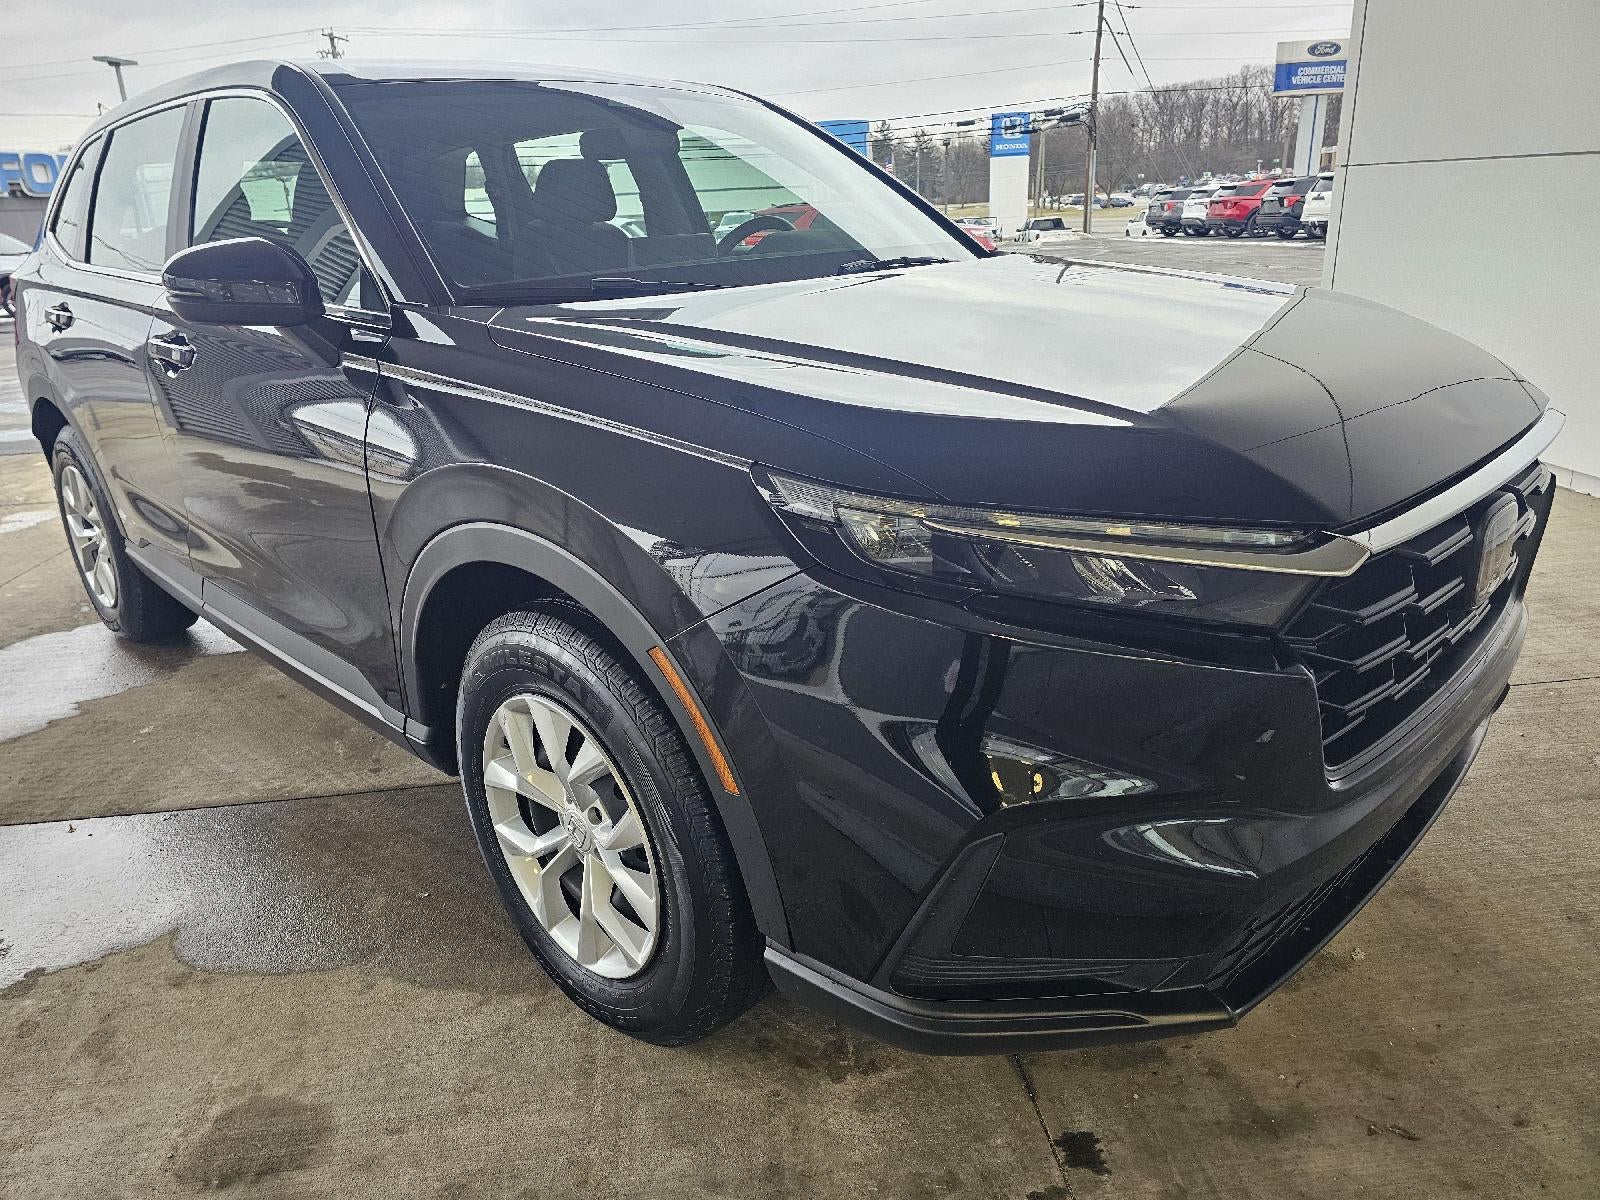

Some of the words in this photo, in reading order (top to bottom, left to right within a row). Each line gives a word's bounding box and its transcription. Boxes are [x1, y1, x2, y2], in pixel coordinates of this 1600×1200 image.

[1314, 43, 1337, 55] Ford
[1298, 66, 1344, 75] COMMERCIAL
[1292, 75, 1322, 84] VEHICLE
[1323, 75, 1344, 83] CENTE
[0, 152, 68, 195] FO
